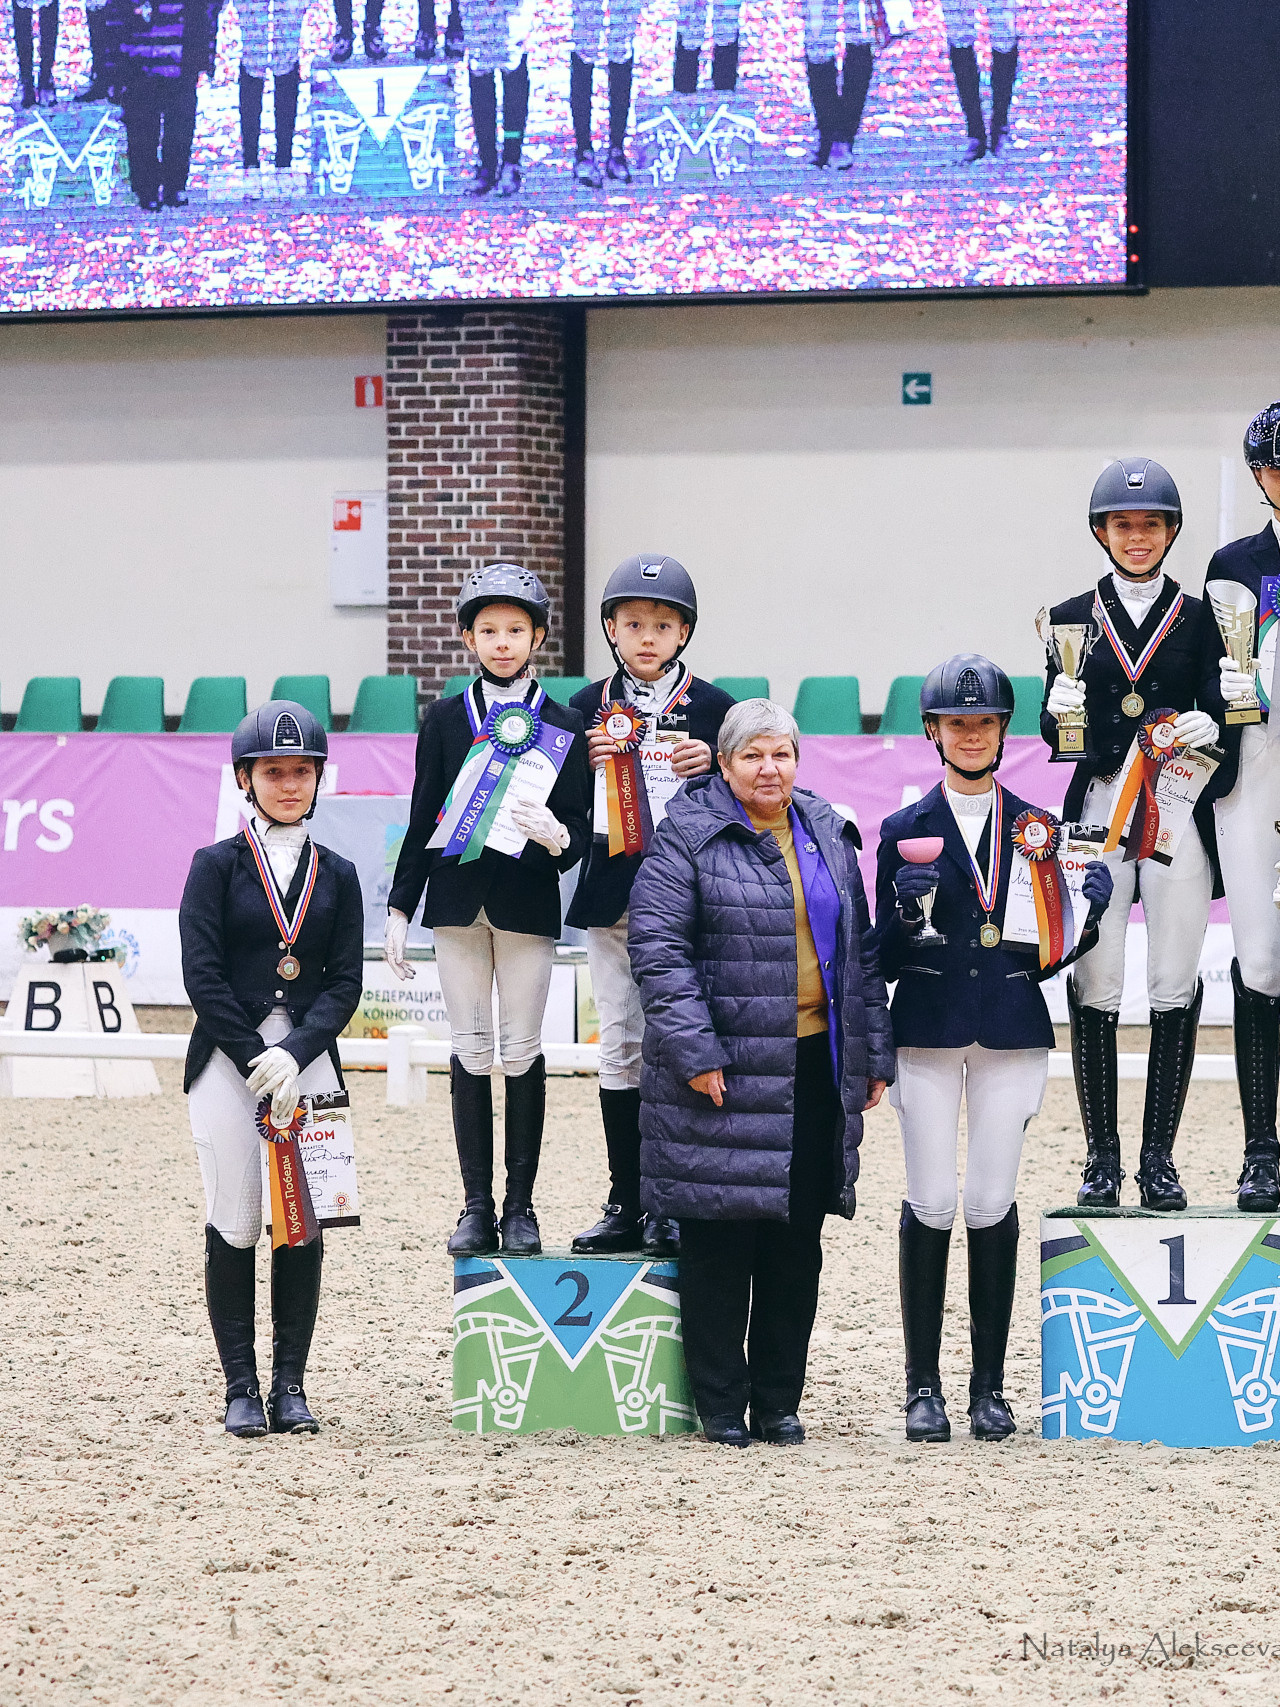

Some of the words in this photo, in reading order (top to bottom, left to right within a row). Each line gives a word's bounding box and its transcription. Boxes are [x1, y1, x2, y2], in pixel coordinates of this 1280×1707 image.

[373, 77, 387, 118] 1
[620, 764, 633, 808] Победы
[455, 789, 490, 843] EURASIA
[624, 811, 638, 844] Кубок
[1145, 817, 1157, 849] Кубок
[1044, 874, 1056, 917] Победы
[25, 981, 62, 1031] B
[93, 981, 122, 1033] B
[363, 989, 441, 1003] ФЕДЕРАЦИЯ
[363, 1009, 426, 1022] КОННОГО
[428, 1009, 450, 1022] СПО
[363, 1027, 388, 1039] РОС
[282, 1155, 295, 1199] Победы
[286, 1200, 301, 1235] Кубок
[1156, 1234, 1197, 1305] 1
[553, 1270, 593, 1327] 2
